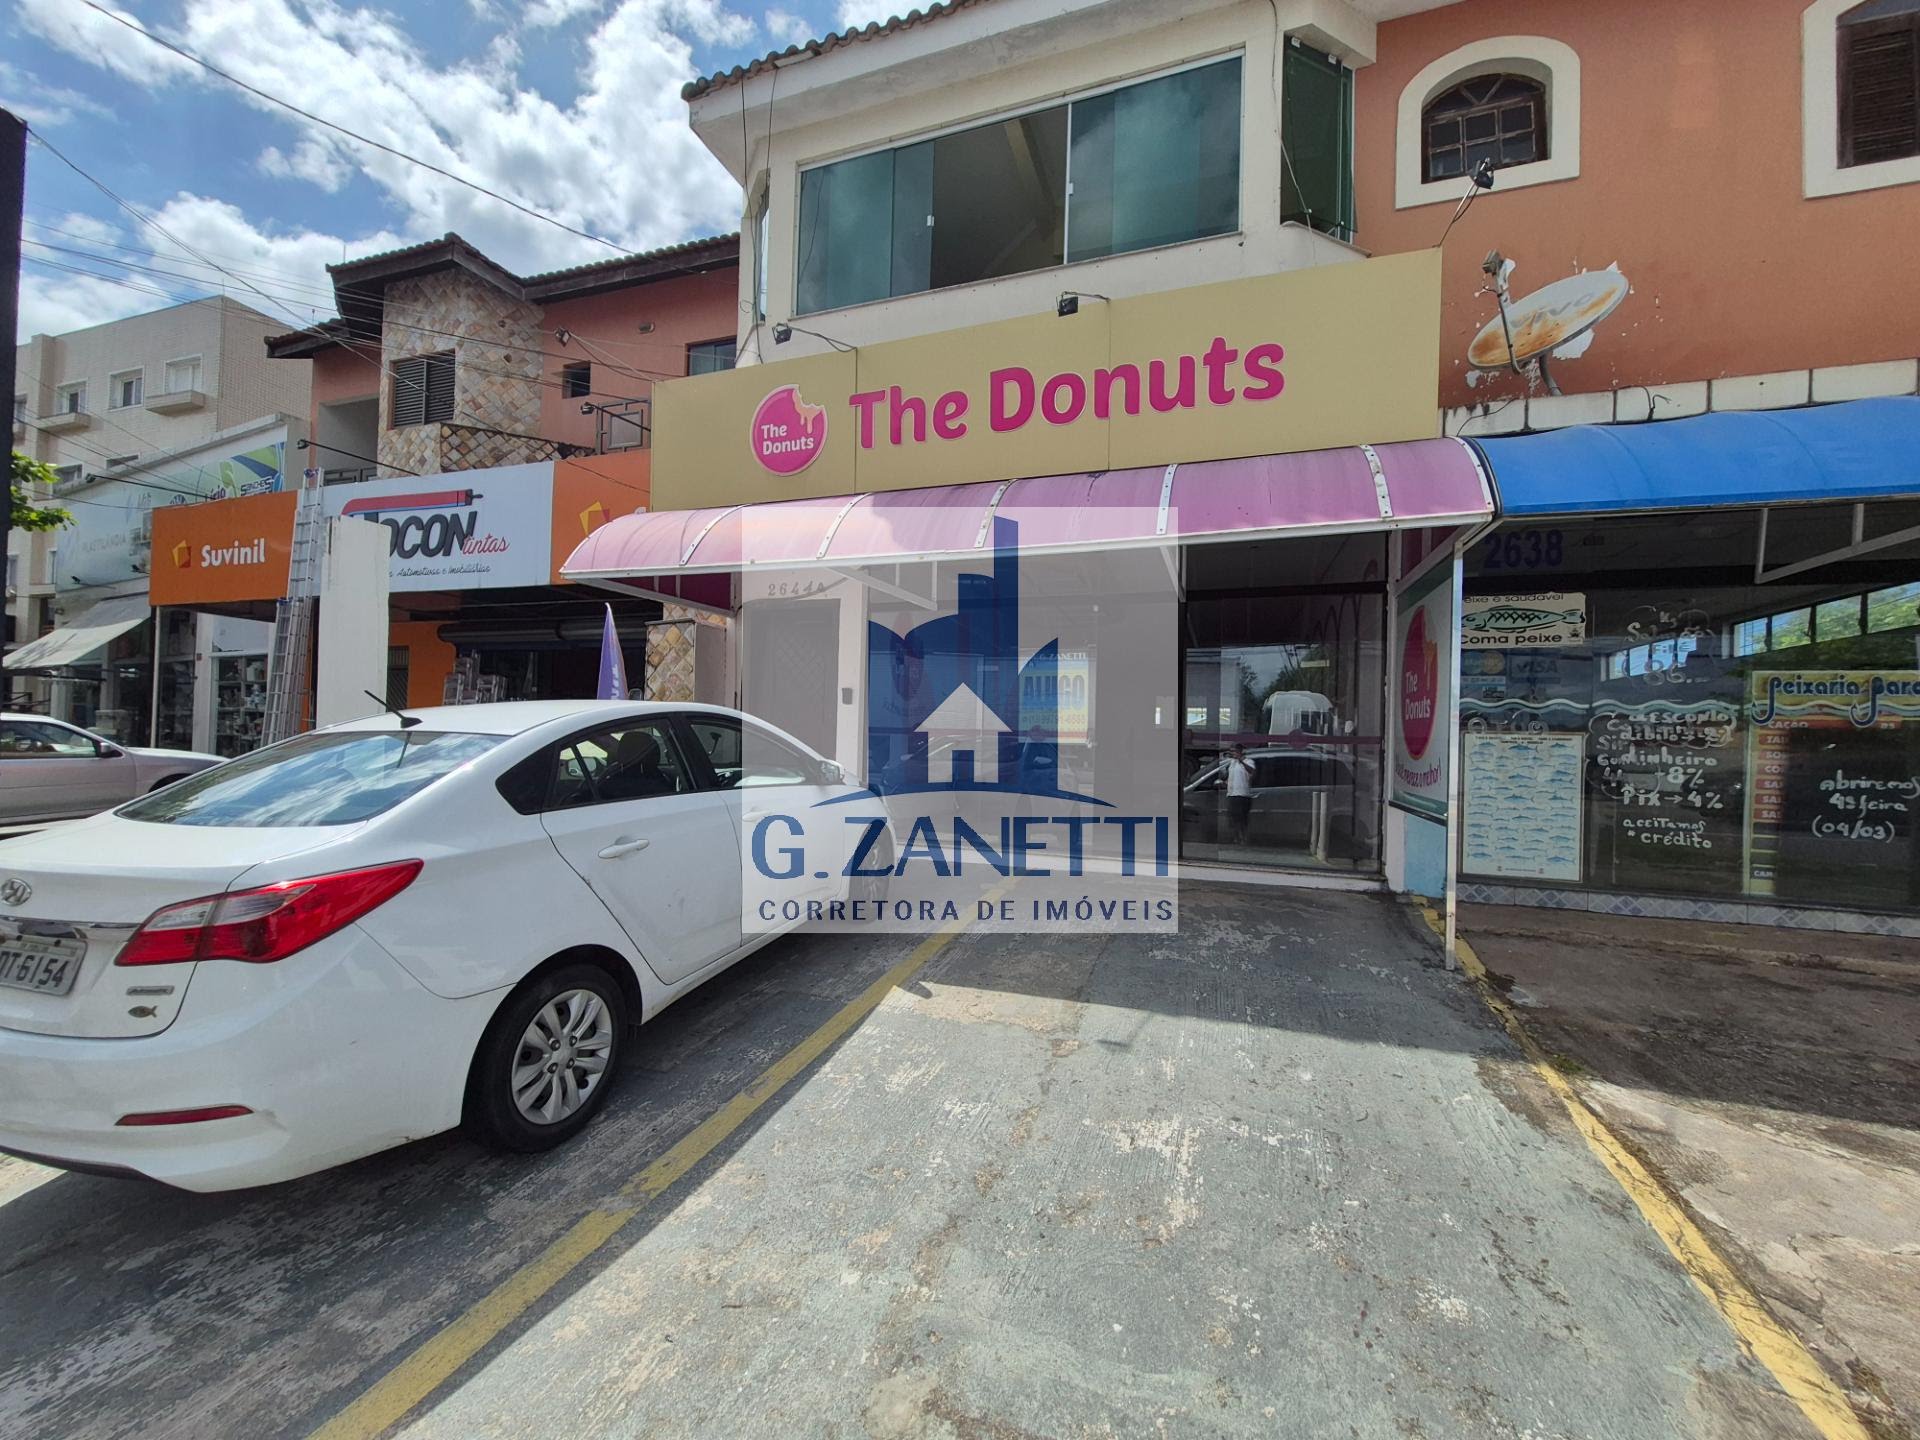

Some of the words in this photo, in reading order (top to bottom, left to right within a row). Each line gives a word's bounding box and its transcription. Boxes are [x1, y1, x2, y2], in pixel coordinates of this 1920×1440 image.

[849, 385, 969, 449] The
[989, 337, 1286, 433] Donuts
[761, 424, 788, 440] The
[763, 437, 815, 455] Donuts
[201, 538, 266, 567] Suvinil
[460, 532, 511, 556] tintas
[1484, 529, 1564, 569] 2638
[1463, 595, 1489, 604] eixe
[1461, 635, 1509, 645] Coma
[1515, 633, 1563, 645] peixe
[1516, 660, 1559, 673] VISA
[1405, 671, 1418, 694] The
[1404, 698, 1431, 721] Donuts
[1752, 674, 1861, 725] Peixaria
[1620, 745, 1718, 767] dinheiro
[1687, 790, 1724, 809] 4%
[1859, 795, 1908, 818] feira
[1640, 831, 1713, 849] crédito
